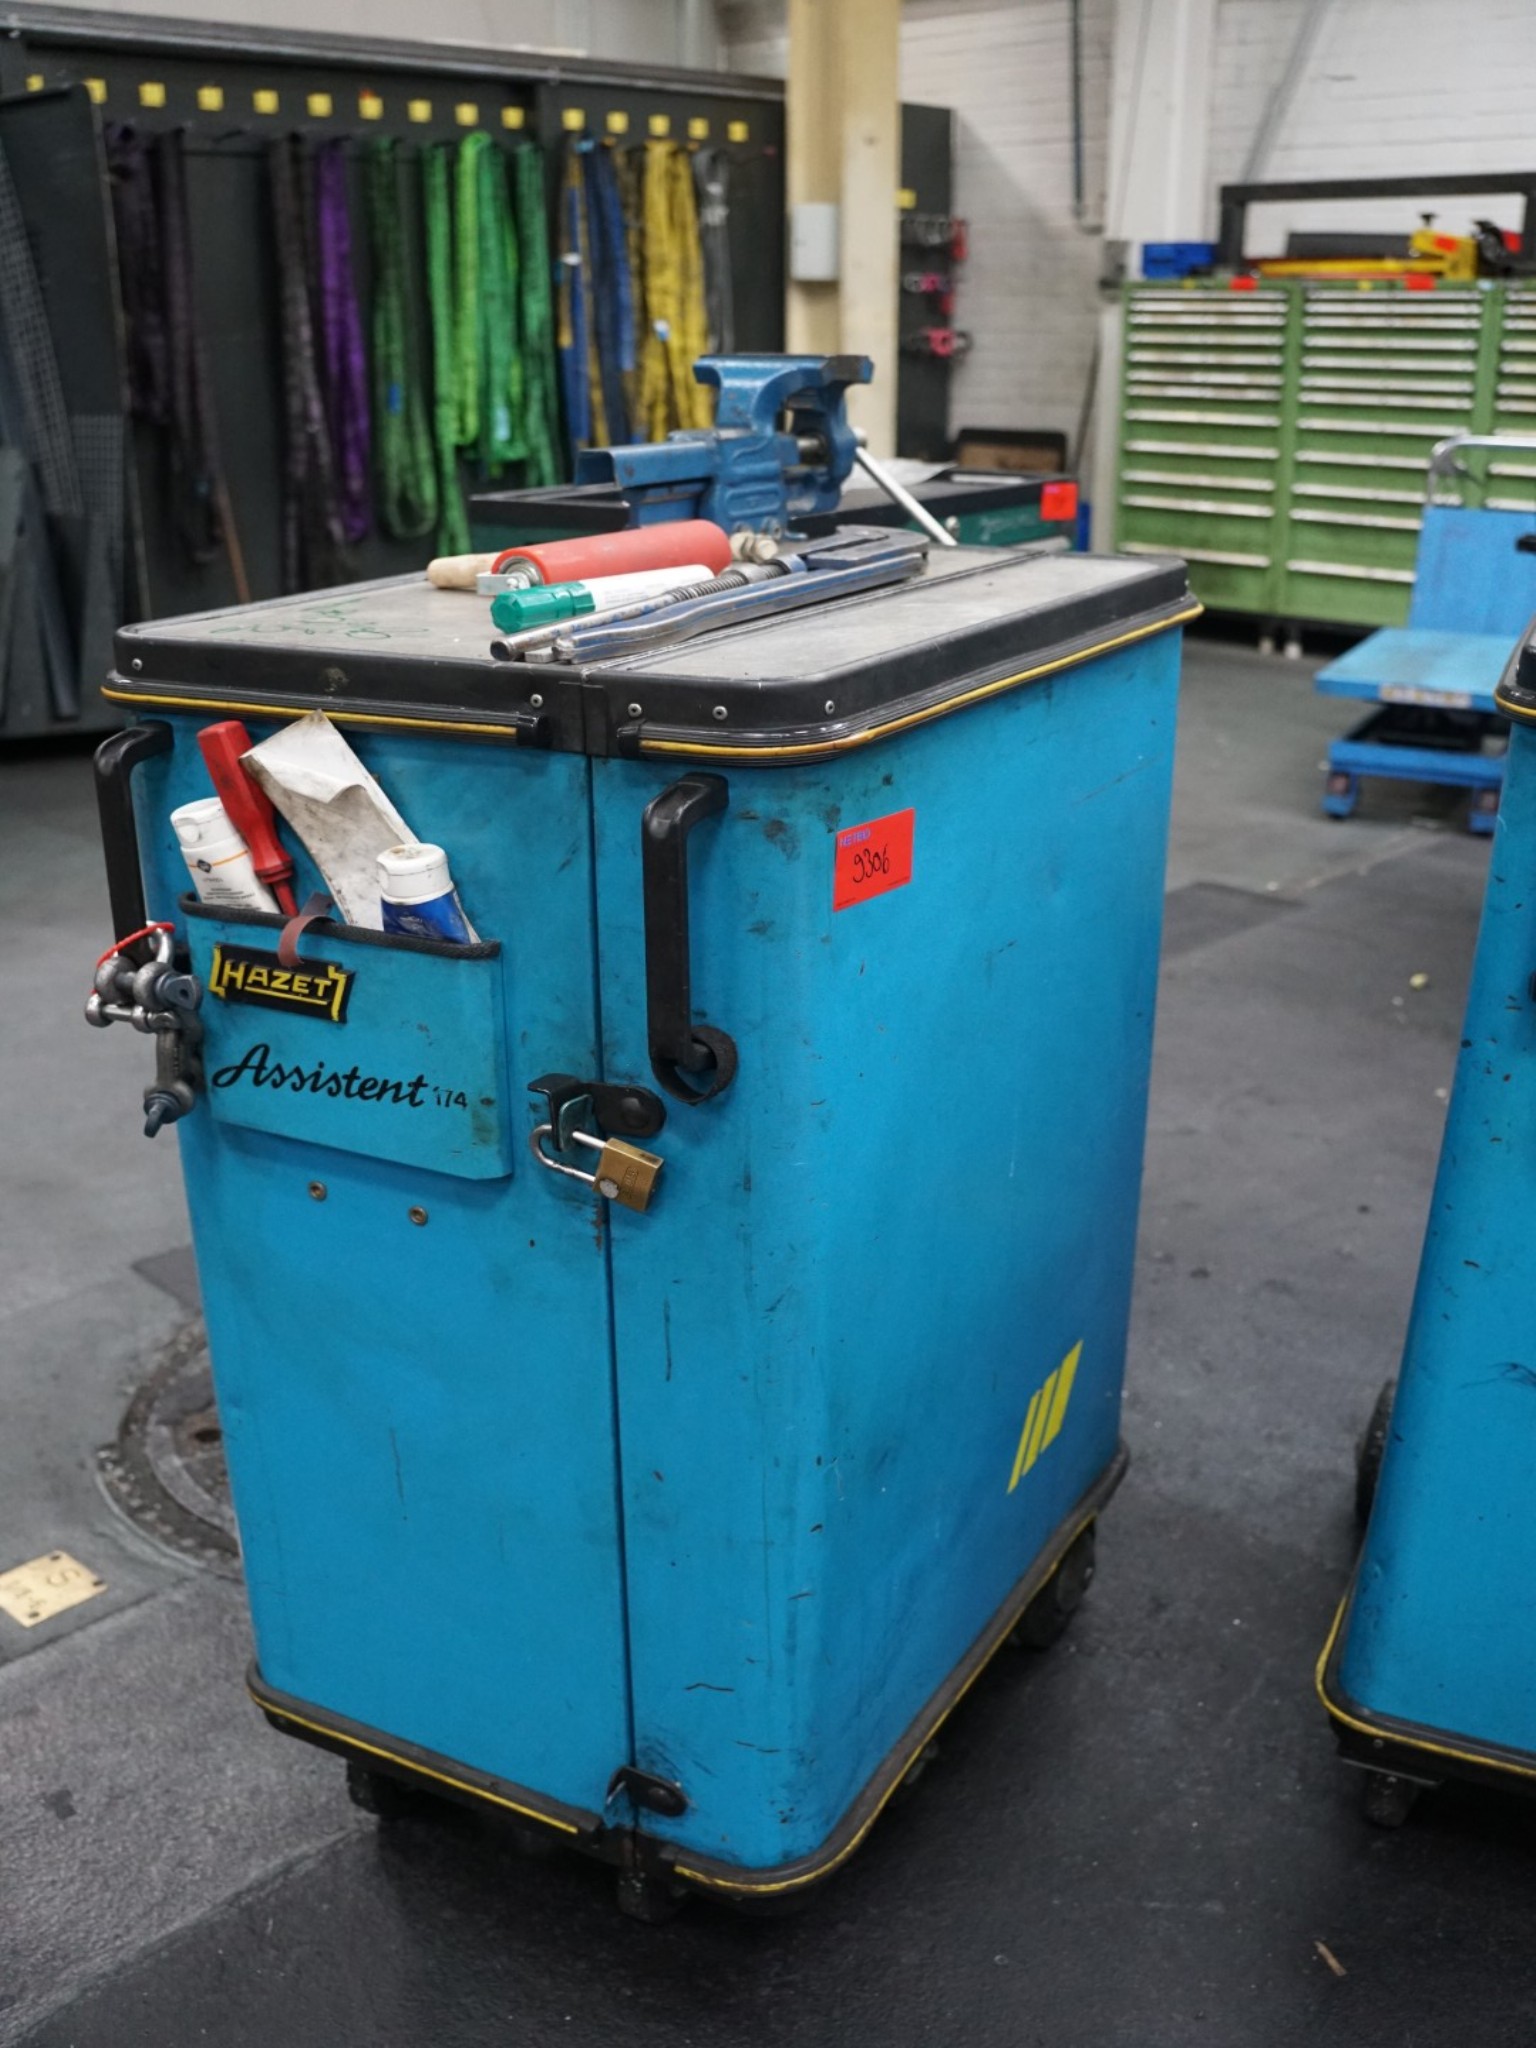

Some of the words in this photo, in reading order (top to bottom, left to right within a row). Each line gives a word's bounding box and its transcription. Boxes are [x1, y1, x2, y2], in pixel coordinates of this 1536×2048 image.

[853, 844, 889, 883] 9306
[222, 959, 332, 998] HAZET
[212, 1044, 429, 1107] Assistent
